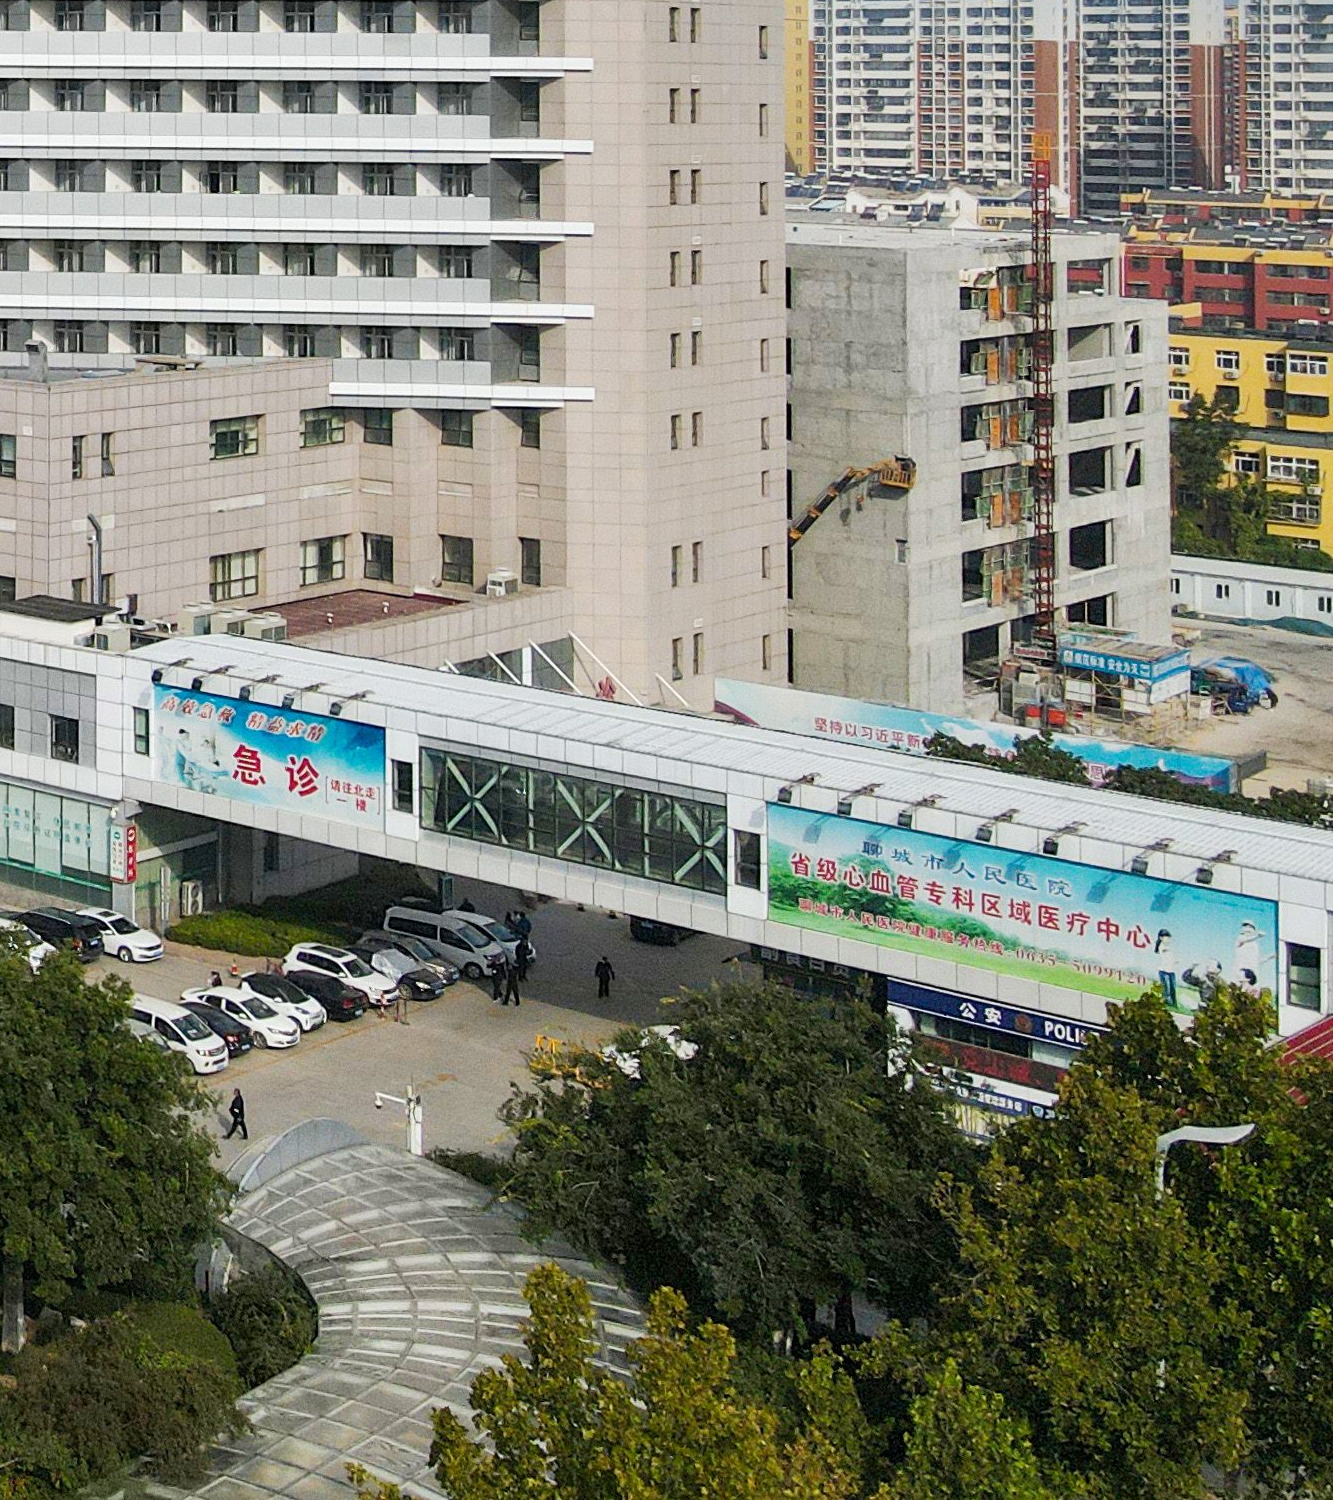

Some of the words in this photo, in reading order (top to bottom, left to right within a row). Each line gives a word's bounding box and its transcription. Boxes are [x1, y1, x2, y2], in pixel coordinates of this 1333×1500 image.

[813, 716, 933, 752] 坚持以习近平新
[231, 743, 321, 798] 急诊
[861, 840, 1073, 899] 聊城市人民医院
[790, 851, 1152, 950] 省级心血管专科区域医疗中心
[957, 1001, 1003, 1027] 公安
[1044, 1020, 1102, 1047] POLI
